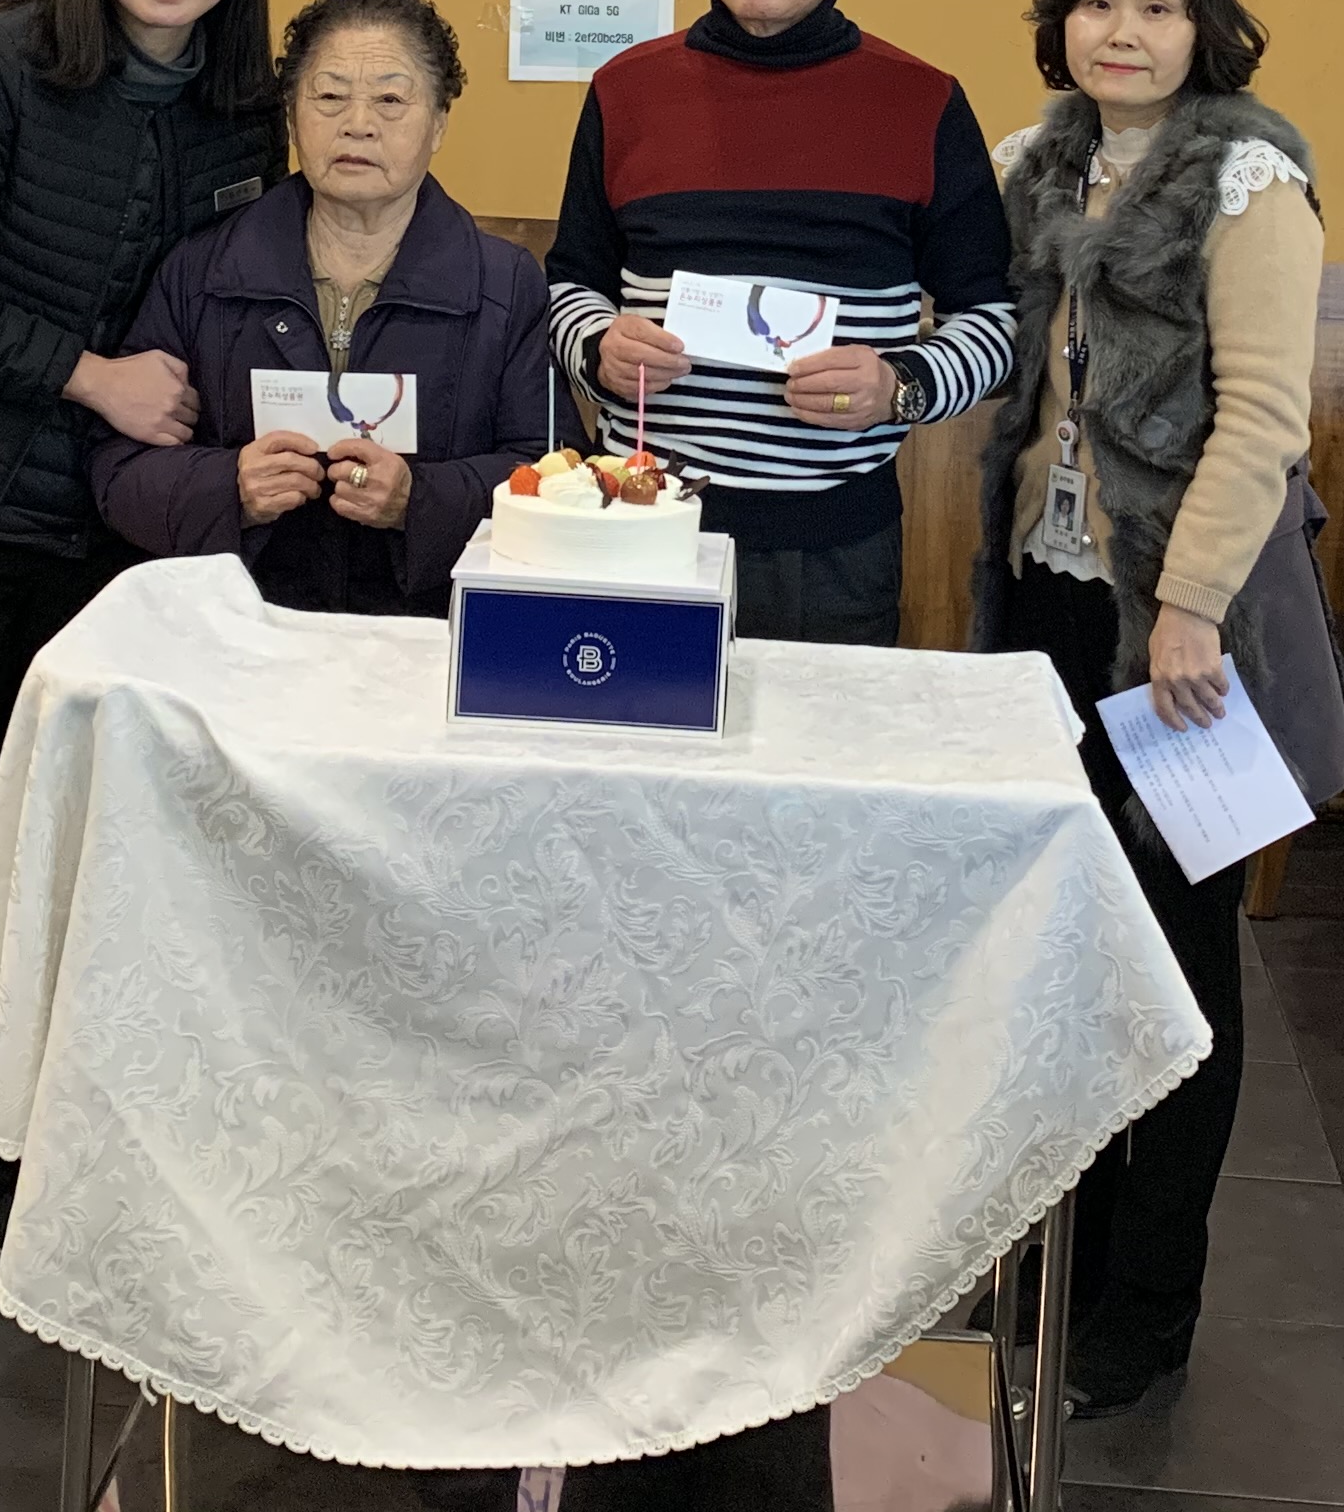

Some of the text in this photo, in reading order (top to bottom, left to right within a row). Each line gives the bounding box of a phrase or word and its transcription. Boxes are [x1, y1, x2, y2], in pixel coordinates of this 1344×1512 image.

[559, 4, 572, 15] KT
[606, 5, 620, 17] 5G
[545, 31, 565, 43] 비번
